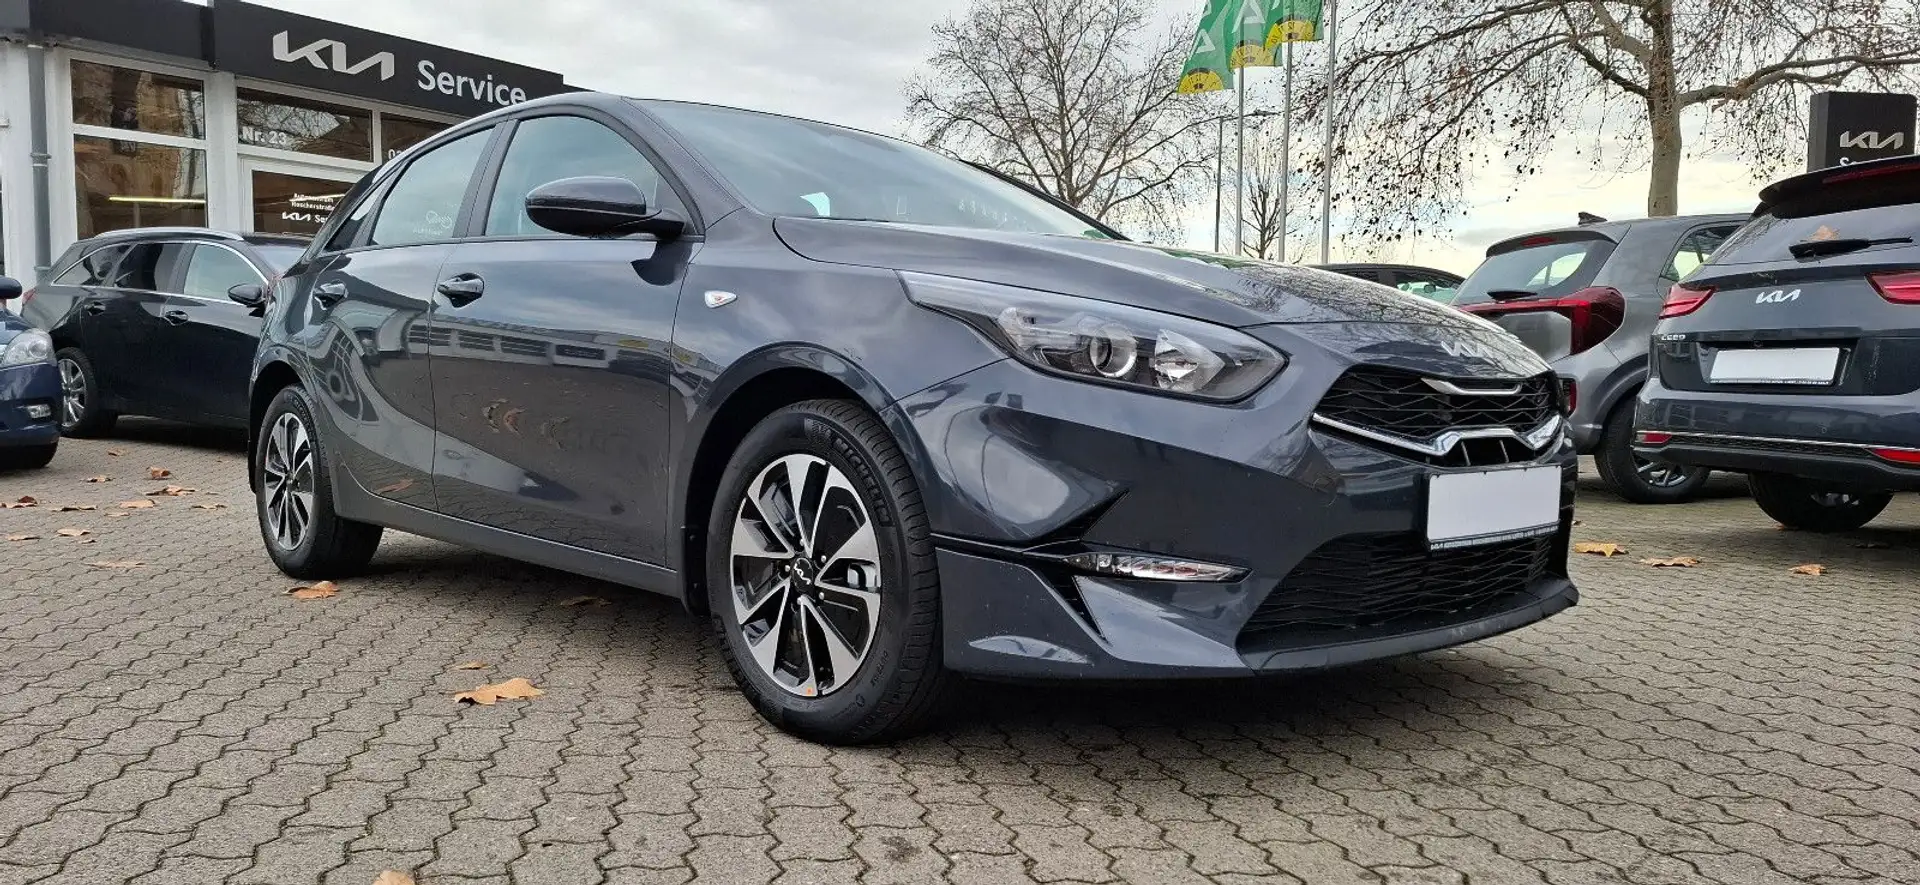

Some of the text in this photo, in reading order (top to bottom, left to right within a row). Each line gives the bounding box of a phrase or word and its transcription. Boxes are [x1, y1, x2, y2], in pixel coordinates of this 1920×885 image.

[272, 30, 527, 106] KIA Service
[241, 126, 288, 146] Nr. 23
[1839, 130, 1905, 150] KIA
[282, 211, 311, 222] KIA
[1755, 289, 1801, 304] KIA
